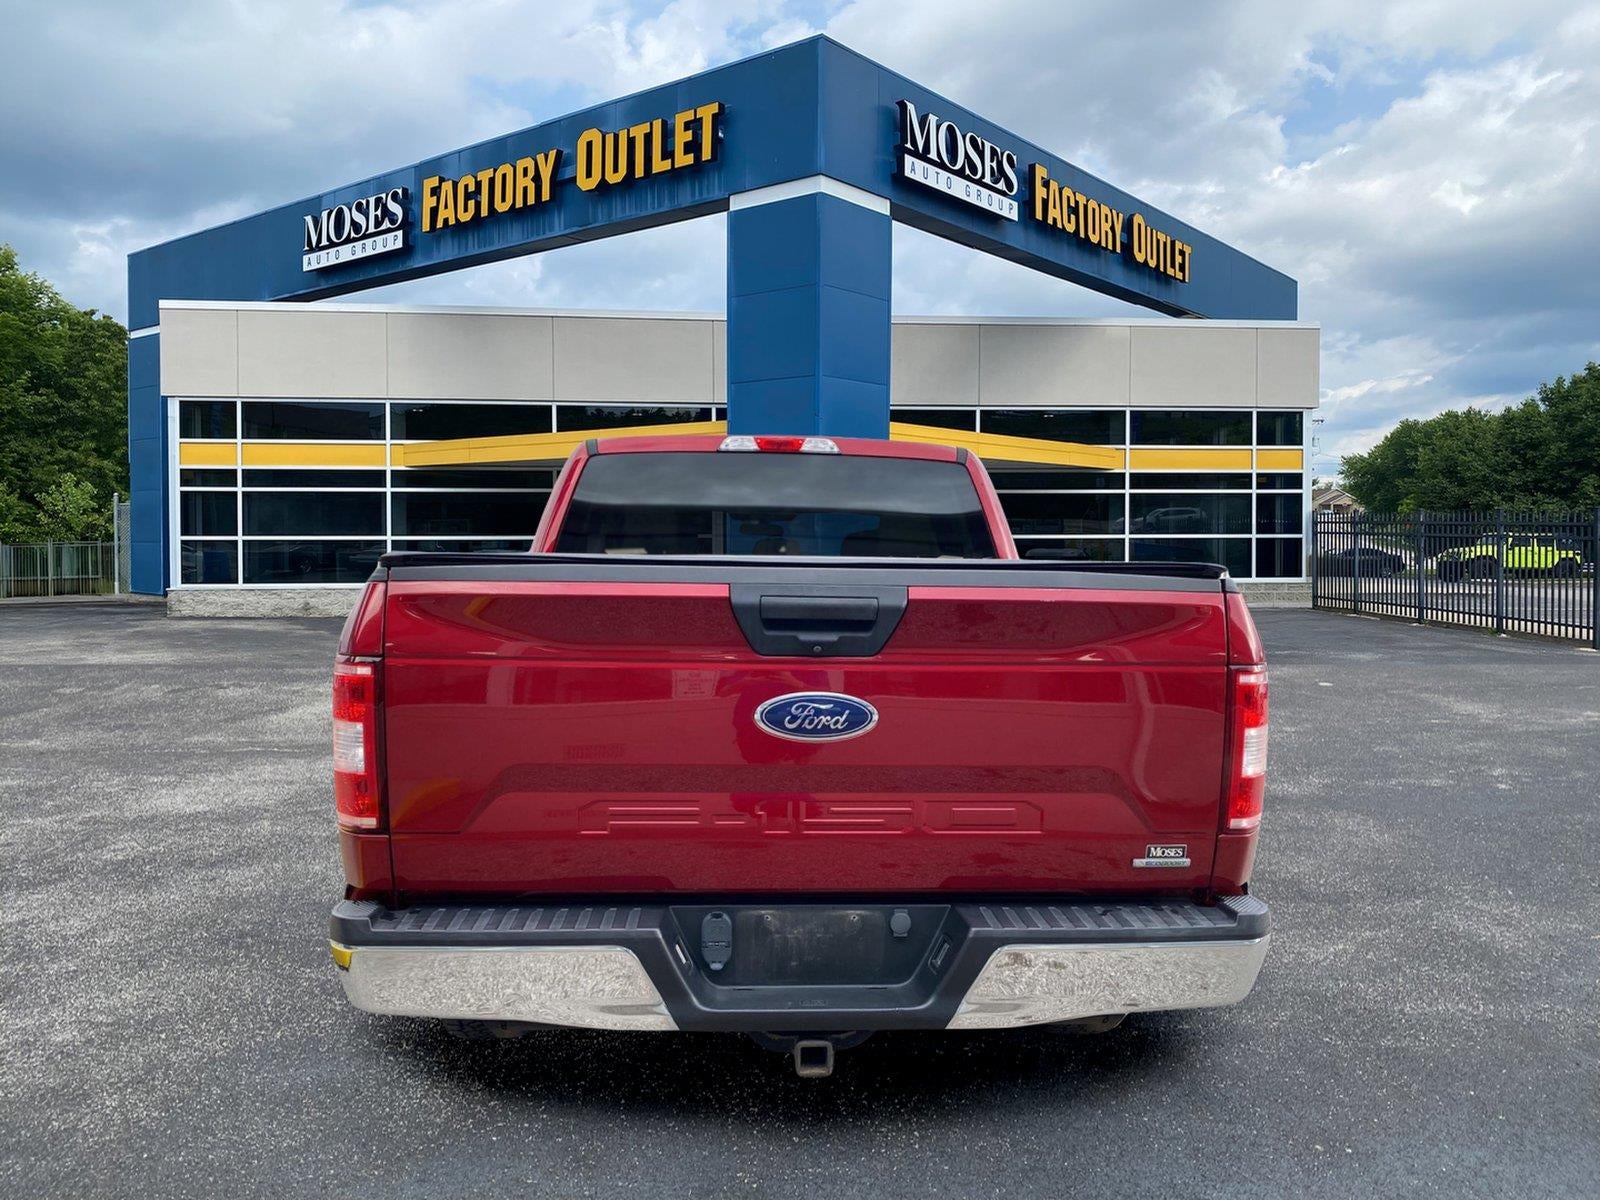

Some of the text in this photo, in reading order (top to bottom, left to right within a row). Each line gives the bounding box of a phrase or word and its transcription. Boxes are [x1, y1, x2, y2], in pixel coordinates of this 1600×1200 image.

[421, 101, 720, 233] FACTORY OUTLET
[903, 99, 1019, 196] MOSES
[909, 160, 1015, 215] AUTO GROUP
[303, 187, 404, 251] MOSES
[1034, 163, 1192, 283] FACTORY OUTLET
[306, 234, 399, 267] AUTO GROUP
[784, 700, 850, 731] Ford
[578, 800, 1043, 834] F-150
[1149, 847, 1183, 857] MOSES
